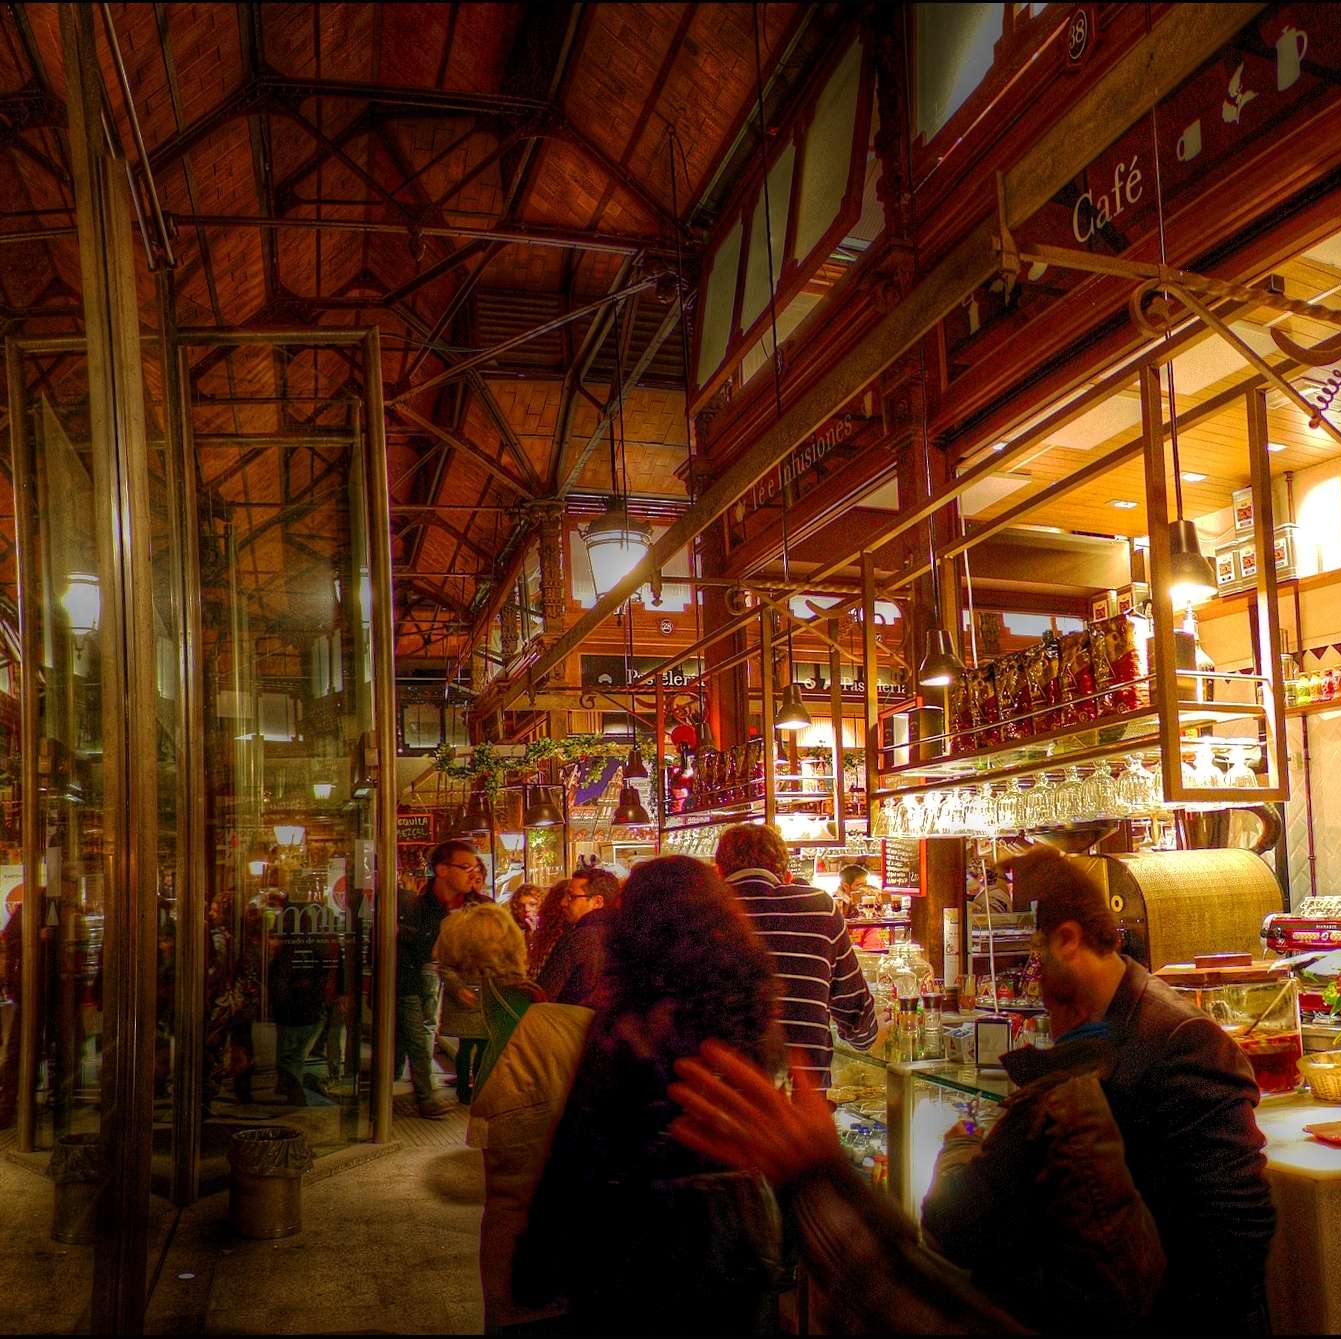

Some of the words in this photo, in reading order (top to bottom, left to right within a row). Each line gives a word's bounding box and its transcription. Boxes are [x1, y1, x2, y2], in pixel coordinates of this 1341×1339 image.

[1073, 156, 1143, 243] Café
[778, 414, 853, 491] Infusiones
[398, 817, 428, 826] EQUILA
